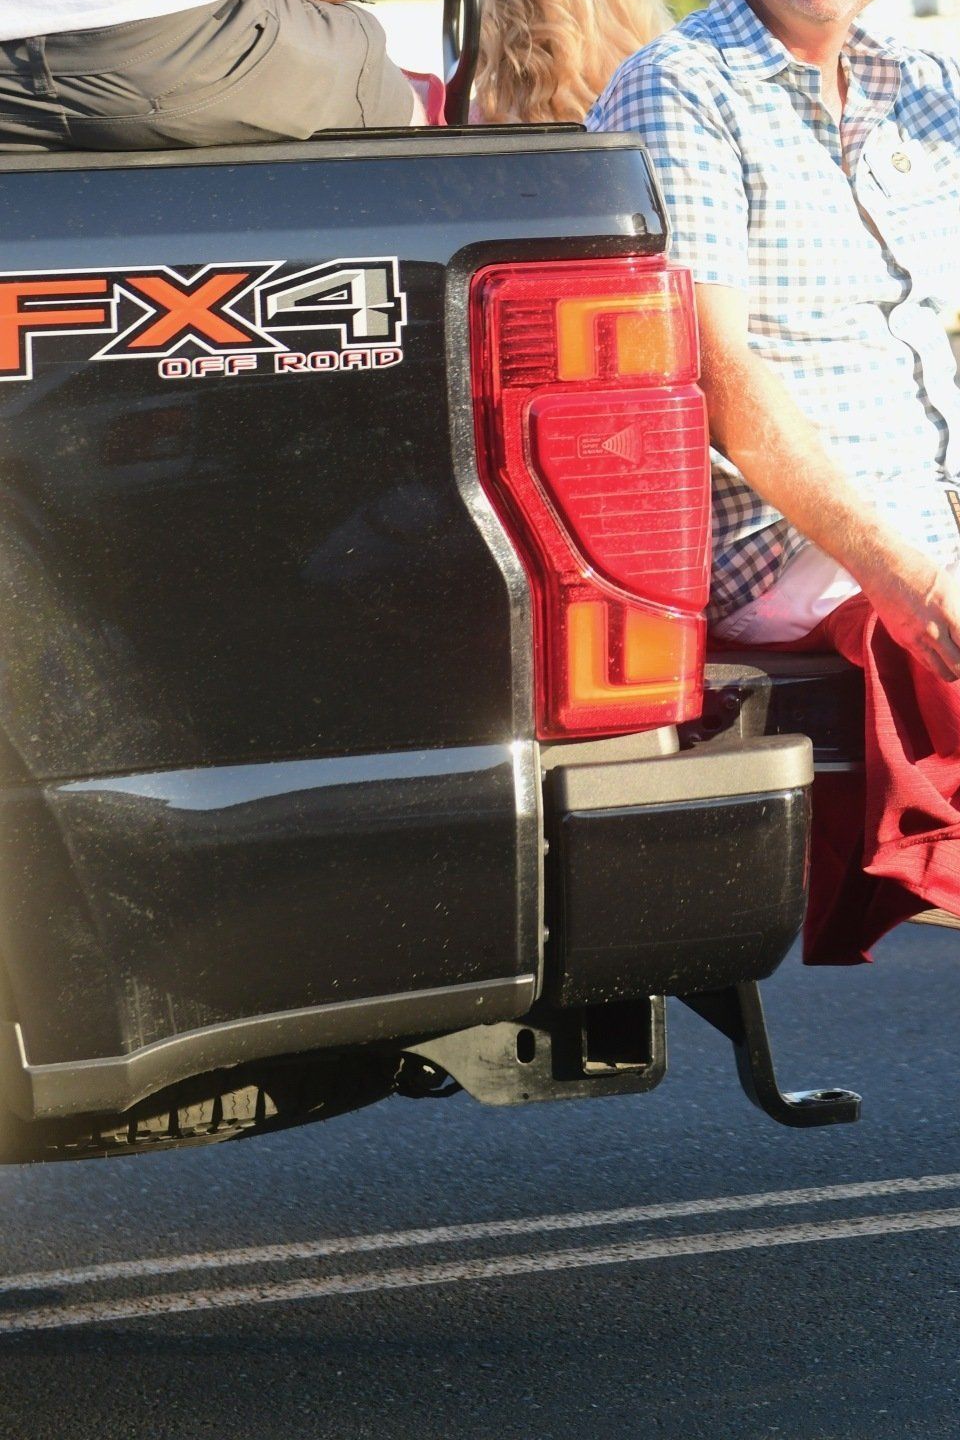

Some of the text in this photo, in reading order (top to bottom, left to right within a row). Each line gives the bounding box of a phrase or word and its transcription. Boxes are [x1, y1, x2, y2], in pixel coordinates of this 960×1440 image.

[0, 258, 404, 378] FX4
[158, 351, 404, 379] OFF ROAD
